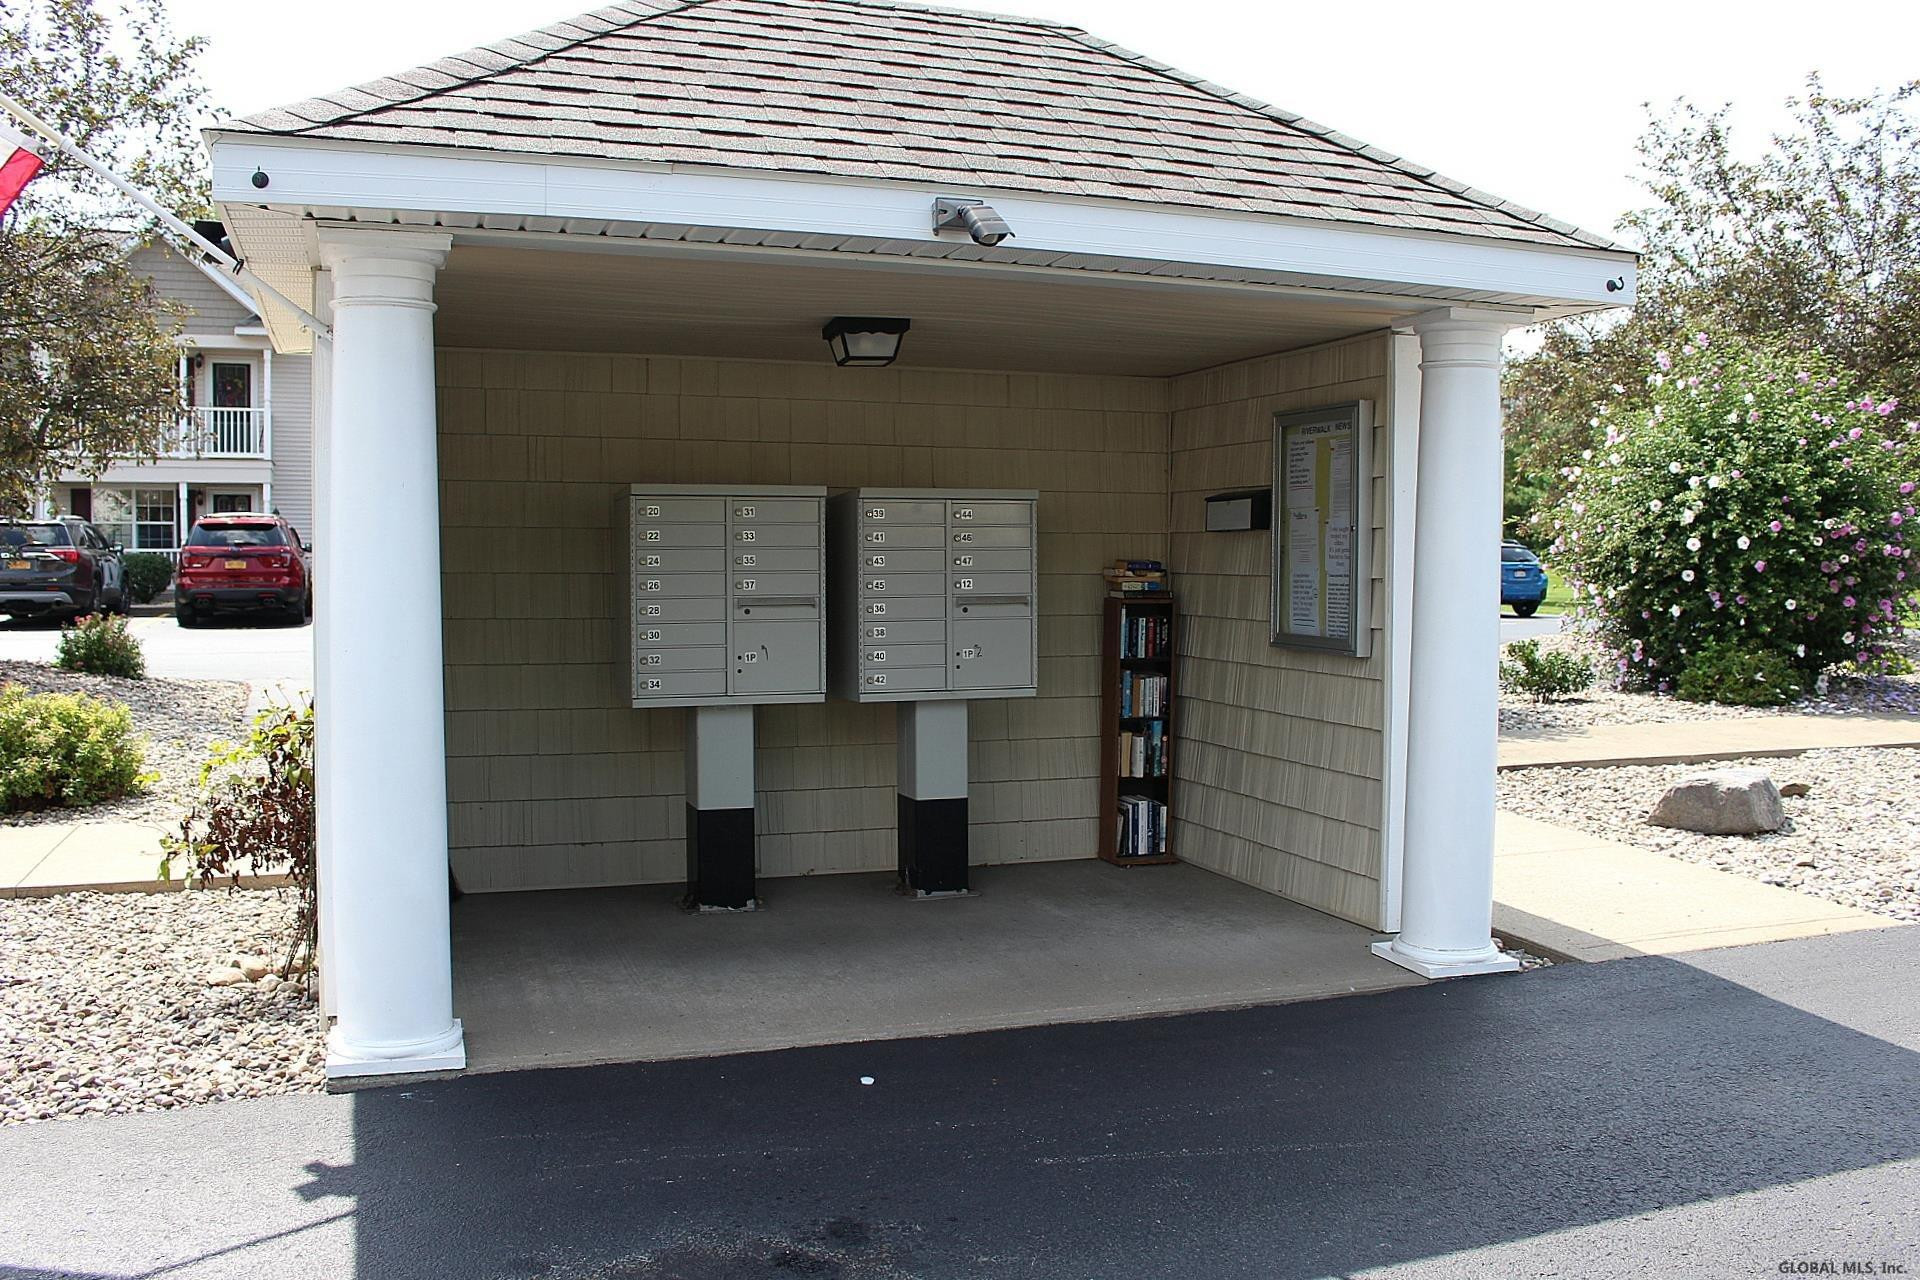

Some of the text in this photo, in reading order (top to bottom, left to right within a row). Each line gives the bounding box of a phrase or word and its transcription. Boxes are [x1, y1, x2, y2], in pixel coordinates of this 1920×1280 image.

[648, 506, 658, 516] 20
[744, 508, 754, 517] 31
[874, 510, 884, 518] 39
[962, 510, 972, 519] 44
[648, 532, 658, 541] 22
[744, 532, 754, 541] 33
[648, 556, 660, 566] 24
[744, 556, 756, 565] 35
[874, 556, 884, 566] 43
[962, 556, 972, 565] 47
[648, 582, 660, 591] 26
[744, 580, 754, 590] 37
[874, 582, 884, 590] 45
[962, 580, 972, 588] 12
[648, 606, 660, 615] 28
[874, 604, 884, 613] 36
[648, 632, 660, 640] 30
[874, 628, 886, 637] 38
[746, 654, 756, 662] 1P
[874, 652, 884, 661] 40
[964, 650, 974, 658] 1P
[648, 656, 660, 665] 32
[650, 680, 660, 689] 34
[874, 676, 886, 684] 42
